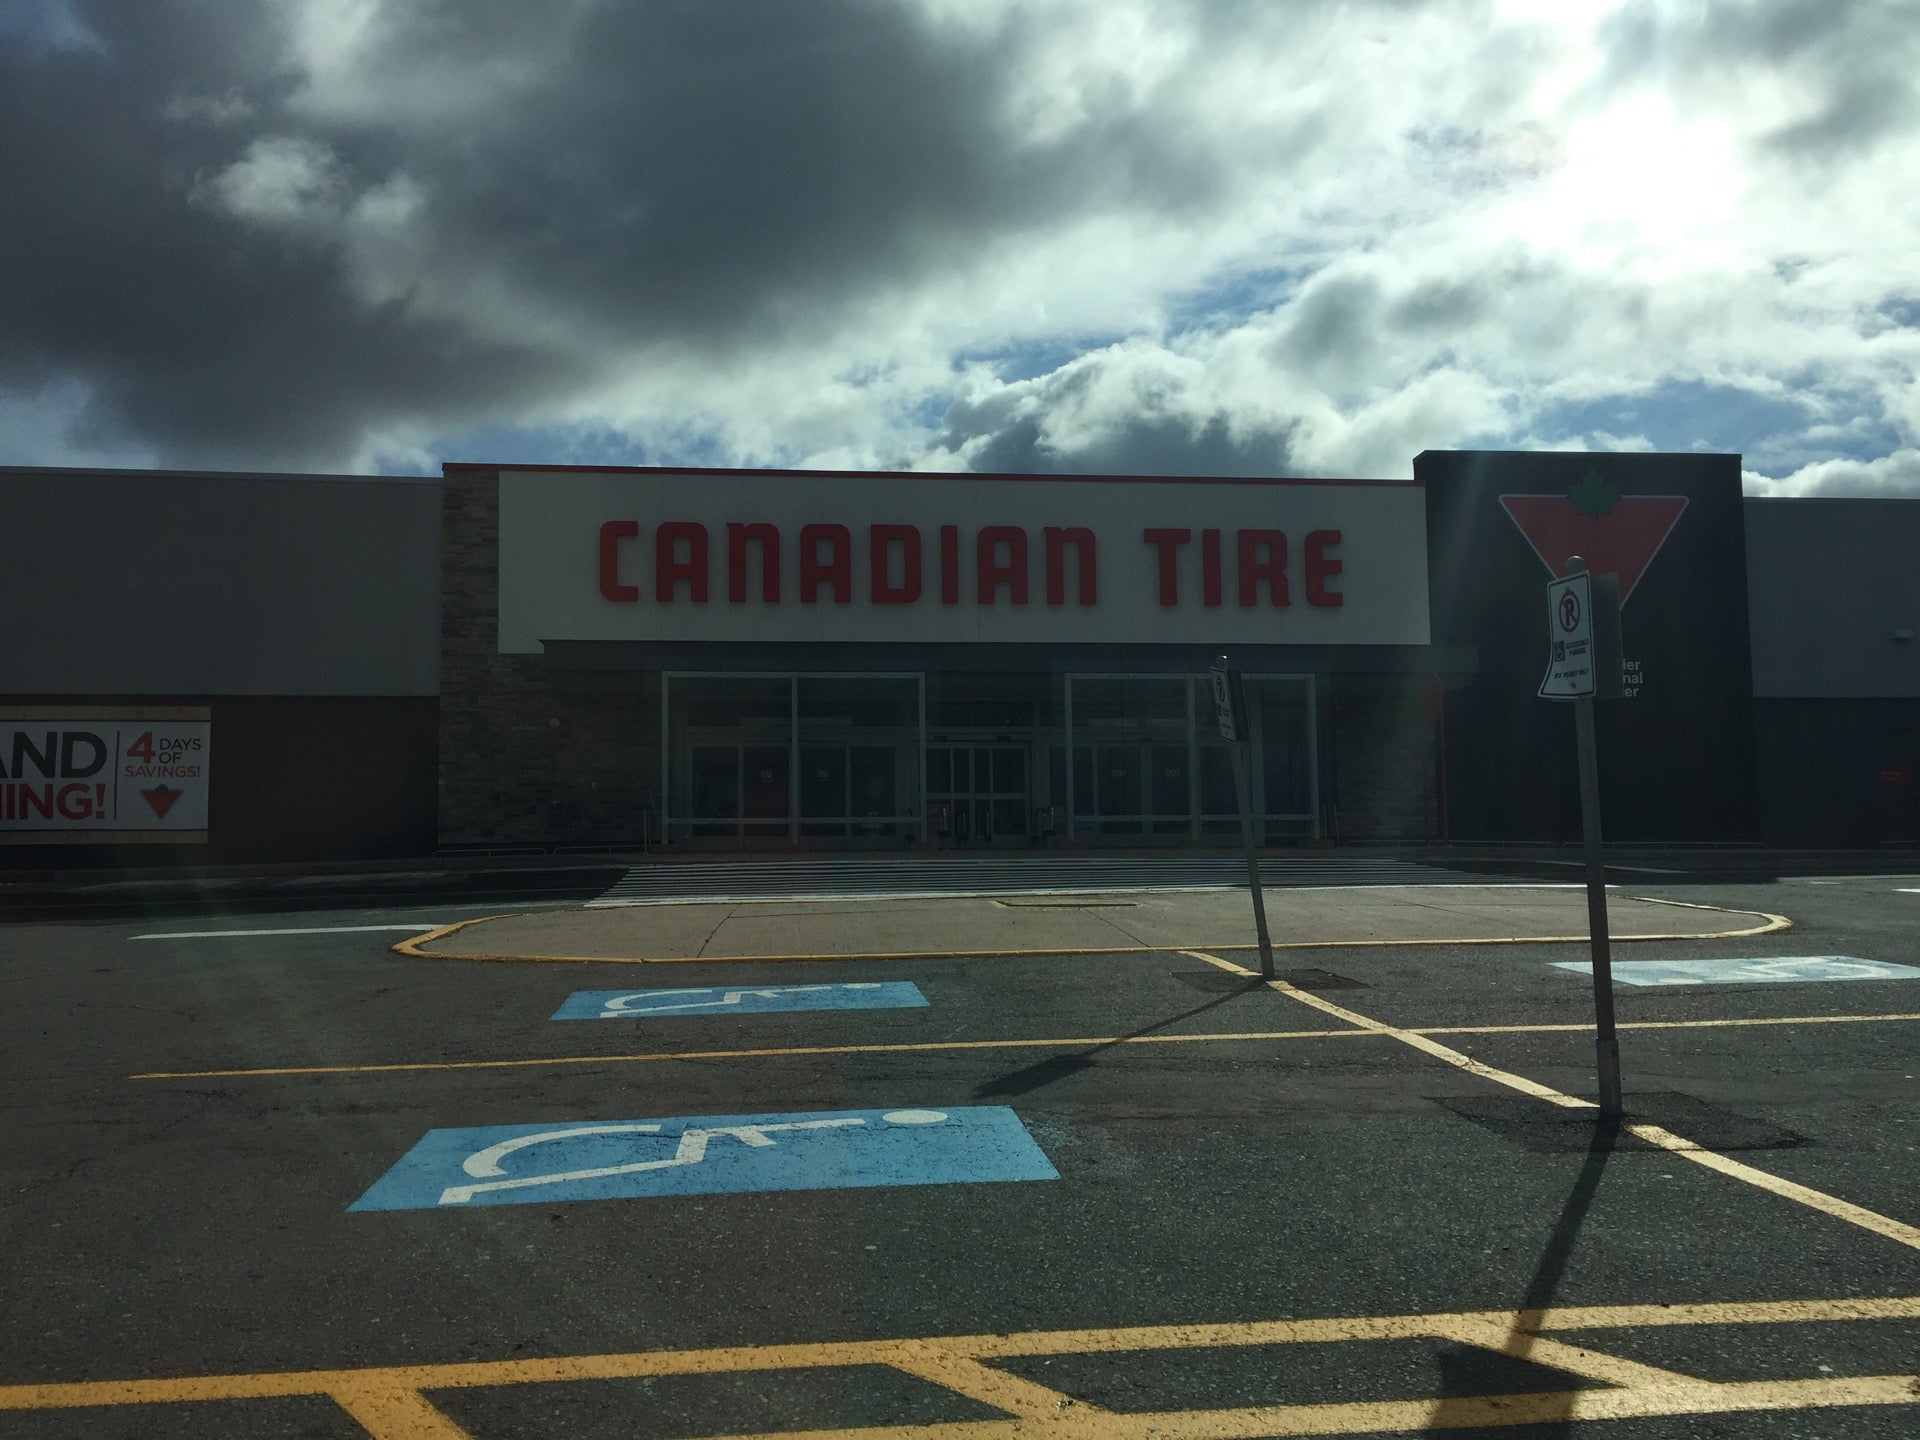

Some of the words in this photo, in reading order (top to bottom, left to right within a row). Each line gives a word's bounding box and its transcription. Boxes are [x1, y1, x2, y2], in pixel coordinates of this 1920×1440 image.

[599, 520, 1098, 606] CANADIAN
[1143, 528, 1344, 608] TIRE
[0, 731, 107, 779] ND
[126, 731, 156, 763] 4
[159, 738, 201, 751] DAYS
[158, 751, 183, 765] OF
[125, 765, 201, 779] SAVINGS!
[0, 783, 106, 820] ING!
